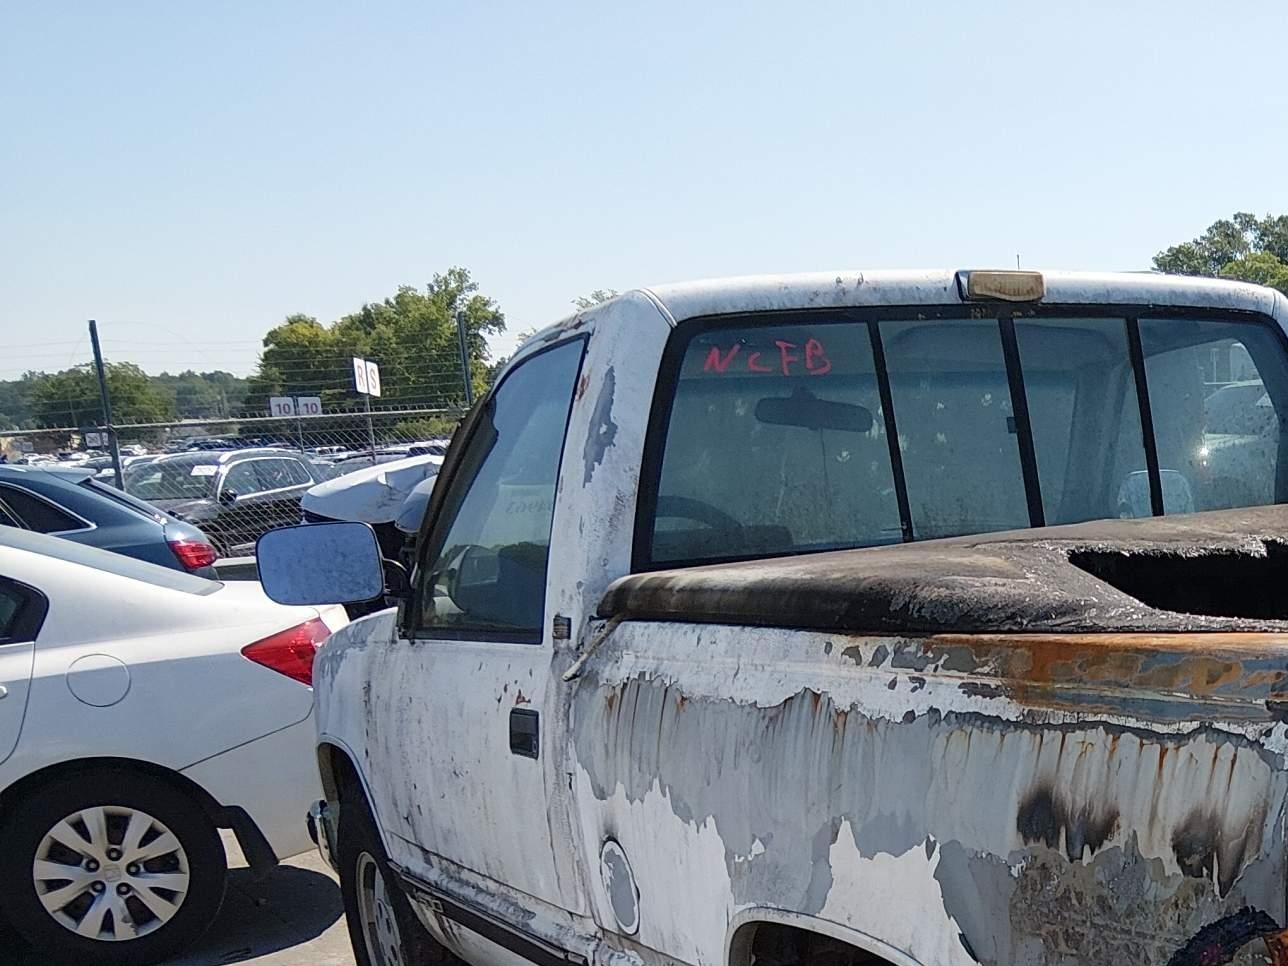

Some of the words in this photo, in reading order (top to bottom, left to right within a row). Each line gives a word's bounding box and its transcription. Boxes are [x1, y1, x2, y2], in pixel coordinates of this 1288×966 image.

[357, 364, 366, 387] R
[369, 366, 377, 389] S
[275, 403, 291, 415] 10
[303, 402, 318, 415] 10
